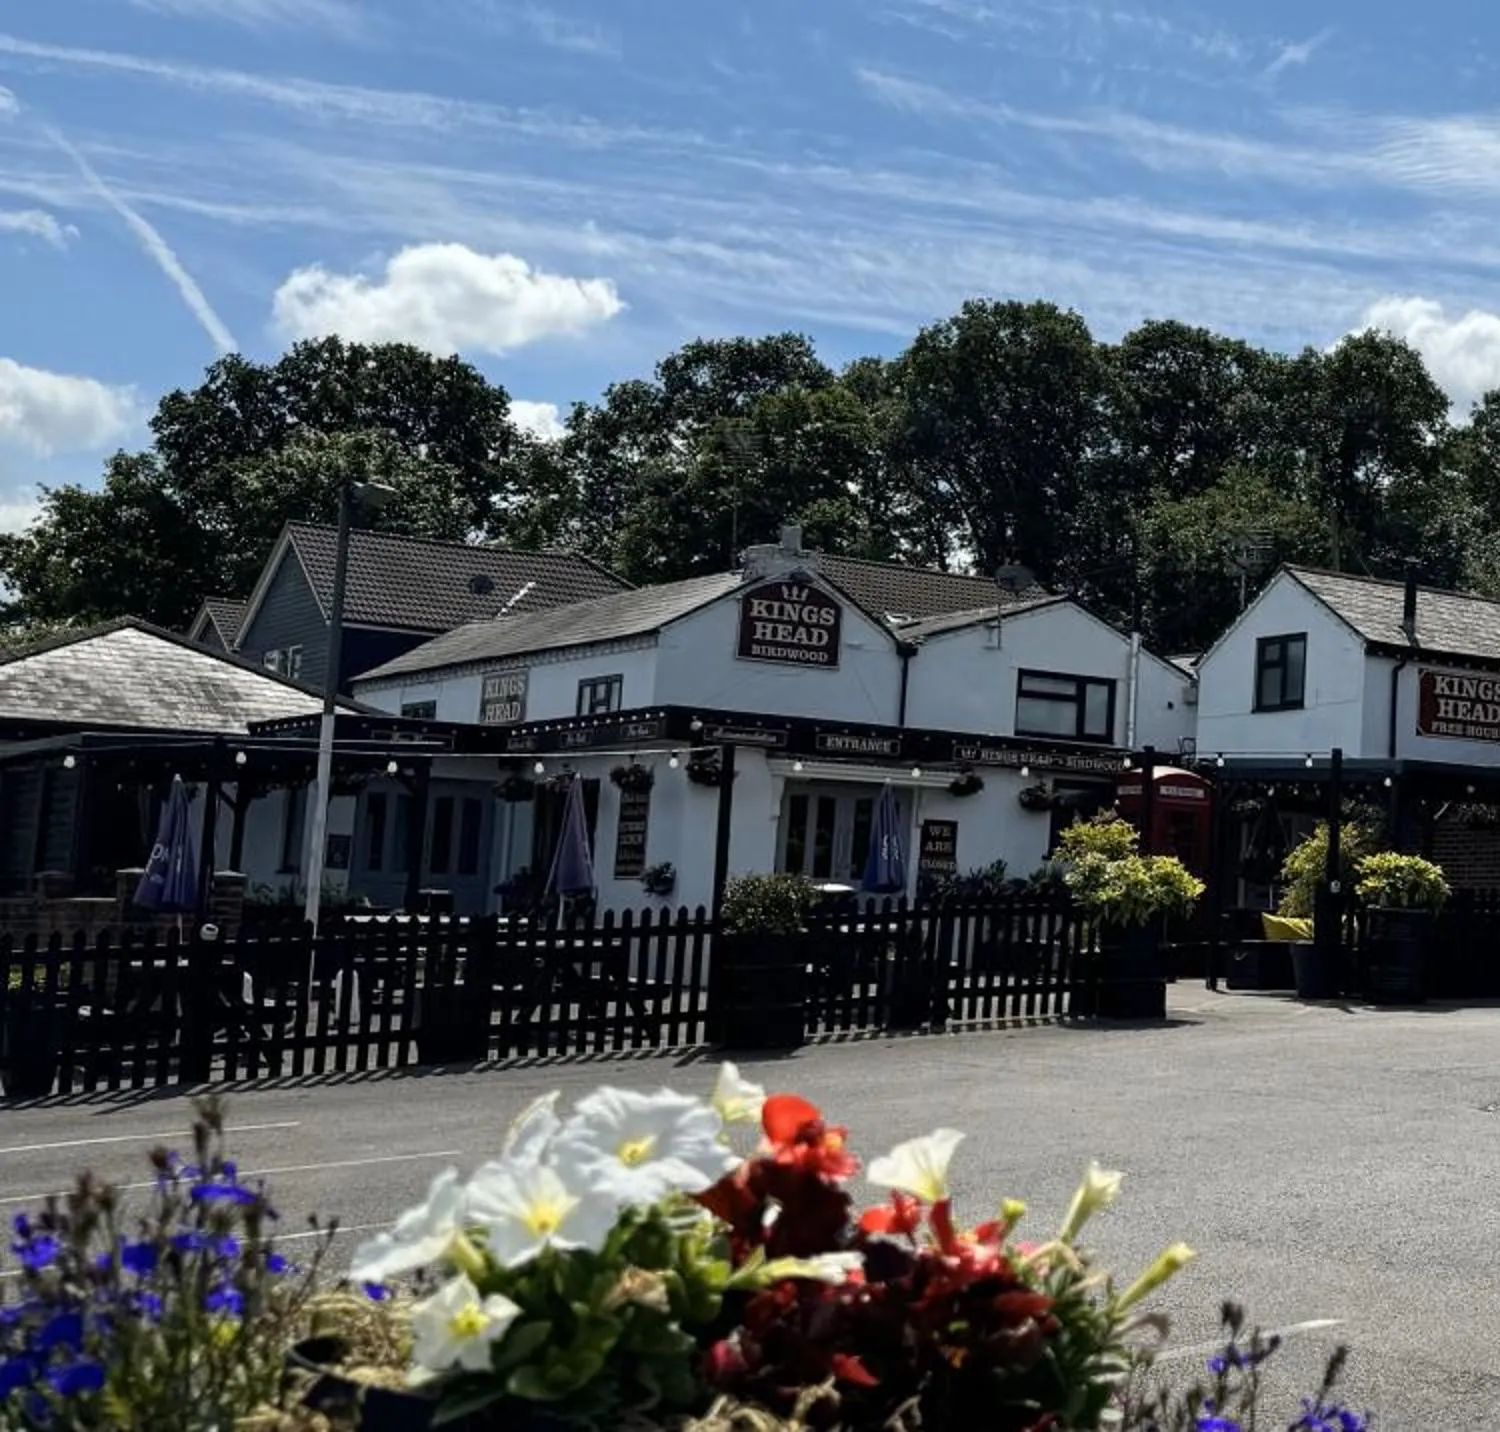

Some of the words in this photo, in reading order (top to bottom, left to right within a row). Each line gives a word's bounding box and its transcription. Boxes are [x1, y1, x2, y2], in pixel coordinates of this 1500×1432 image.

[750, 598, 835, 627] KINGS
[752, 622, 829, 647] HEAD
[751, 644, 829, 662] BIRDWOOD
[485, 676, 525, 699] KINGS
[484, 701, 521, 722] HEAD
[1431, 721, 1464, 735] FREE
[826, 735, 891, 754] ENTRANCE
